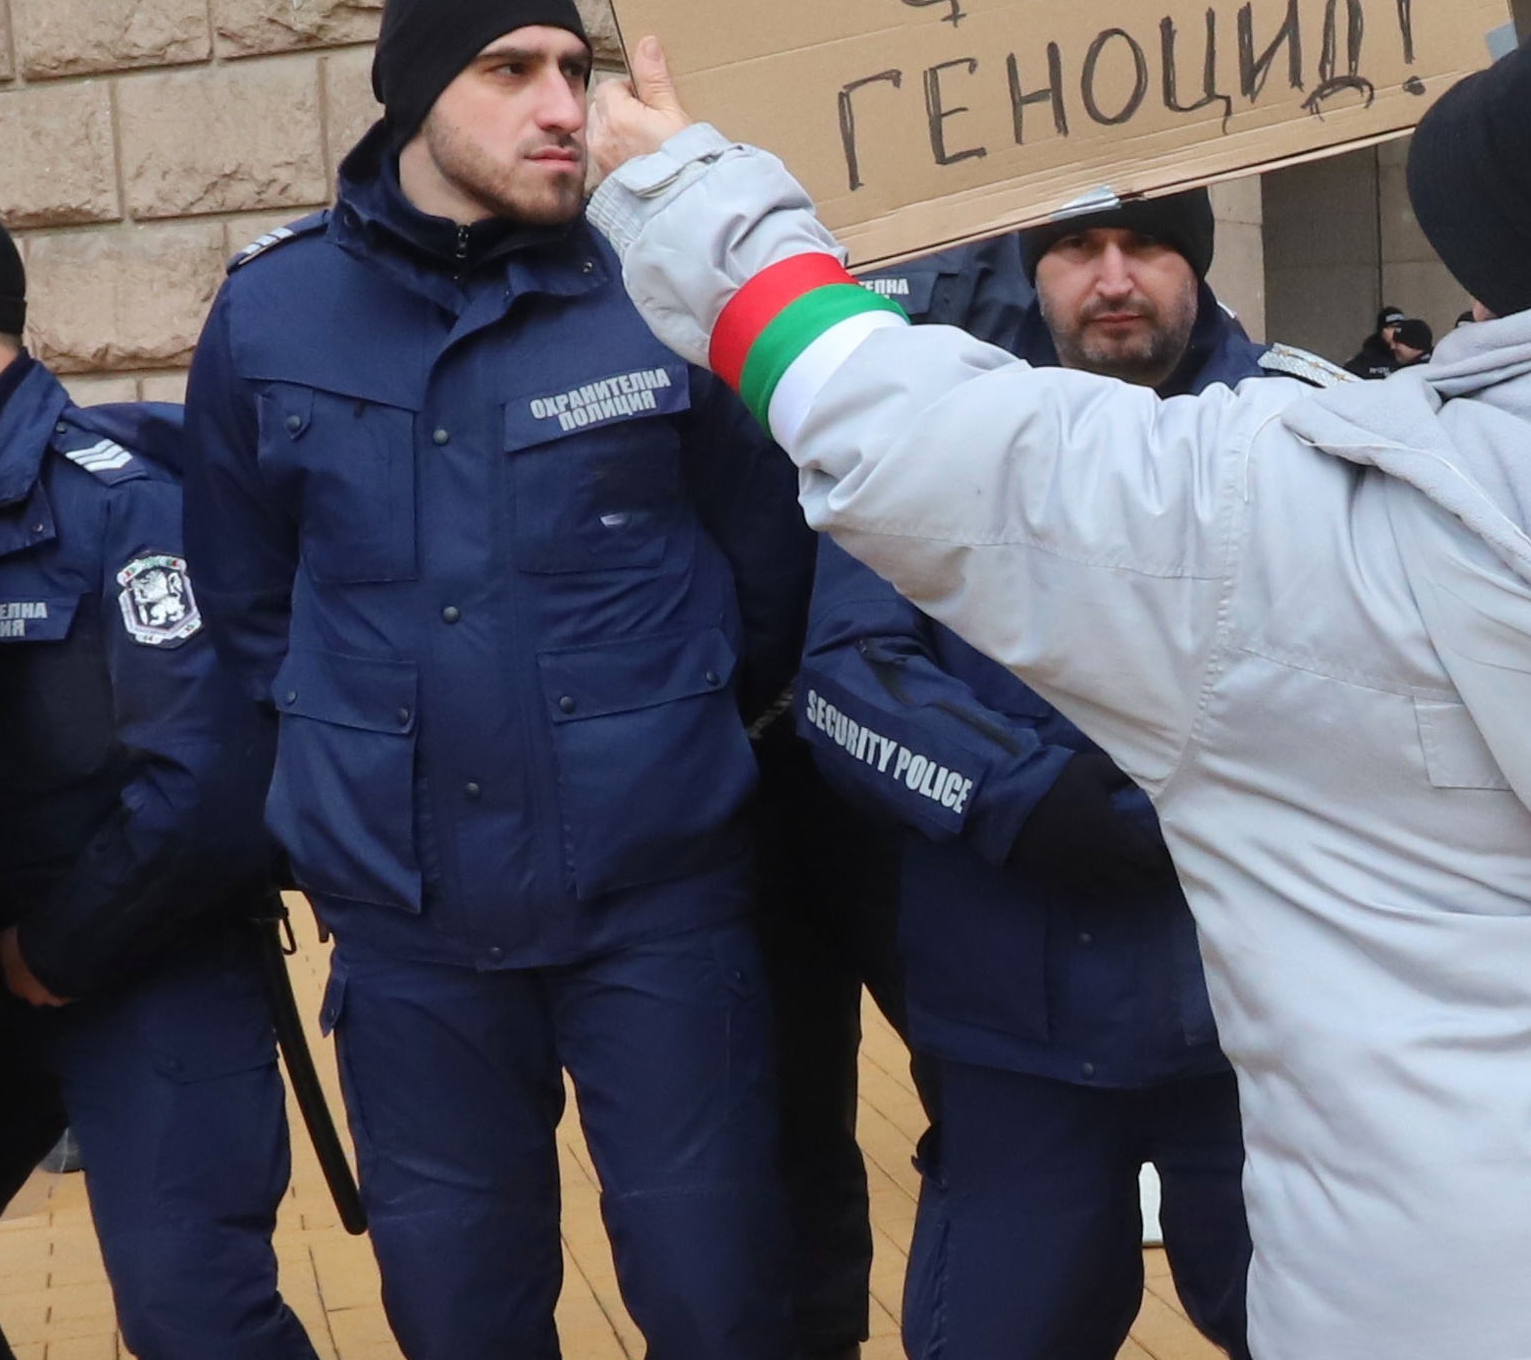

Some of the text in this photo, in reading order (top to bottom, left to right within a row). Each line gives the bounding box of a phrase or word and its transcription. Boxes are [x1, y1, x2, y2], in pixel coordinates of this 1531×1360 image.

[530, 368, 671, 419] ОХРАНИТЕЛНА
[558, 390, 656, 431] ПОЛИЦИЯ
[806, 689, 898, 773] SECURITY
[893, 746, 973, 814] POLICE
